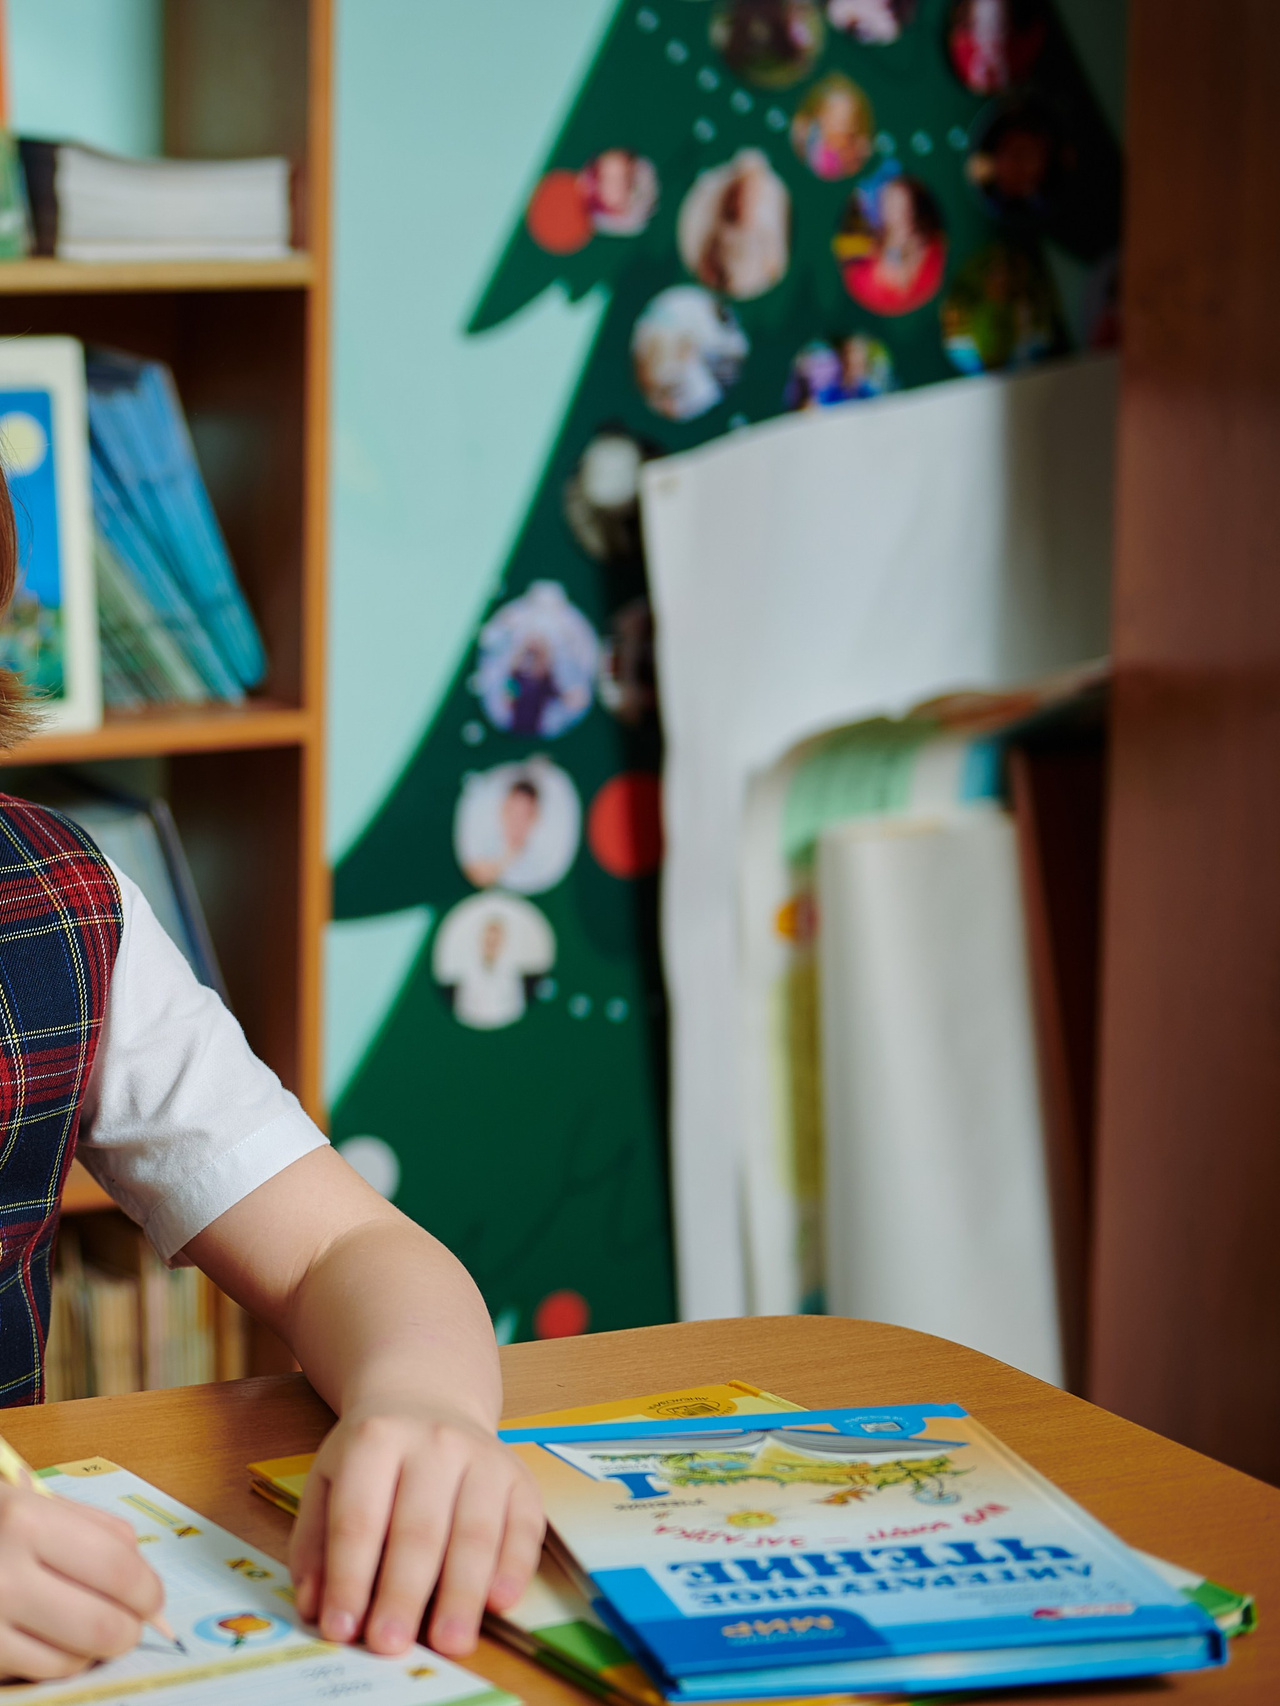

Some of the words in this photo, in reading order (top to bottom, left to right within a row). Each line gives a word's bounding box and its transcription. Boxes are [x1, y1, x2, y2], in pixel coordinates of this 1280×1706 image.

[604, 1472, 670, 1499] 1
[668, 1538, 1076, 1587] ЧТЕНИЕ
[691, 1562, 1093, 1608] ЛИТЕРАТУРНОЕ
